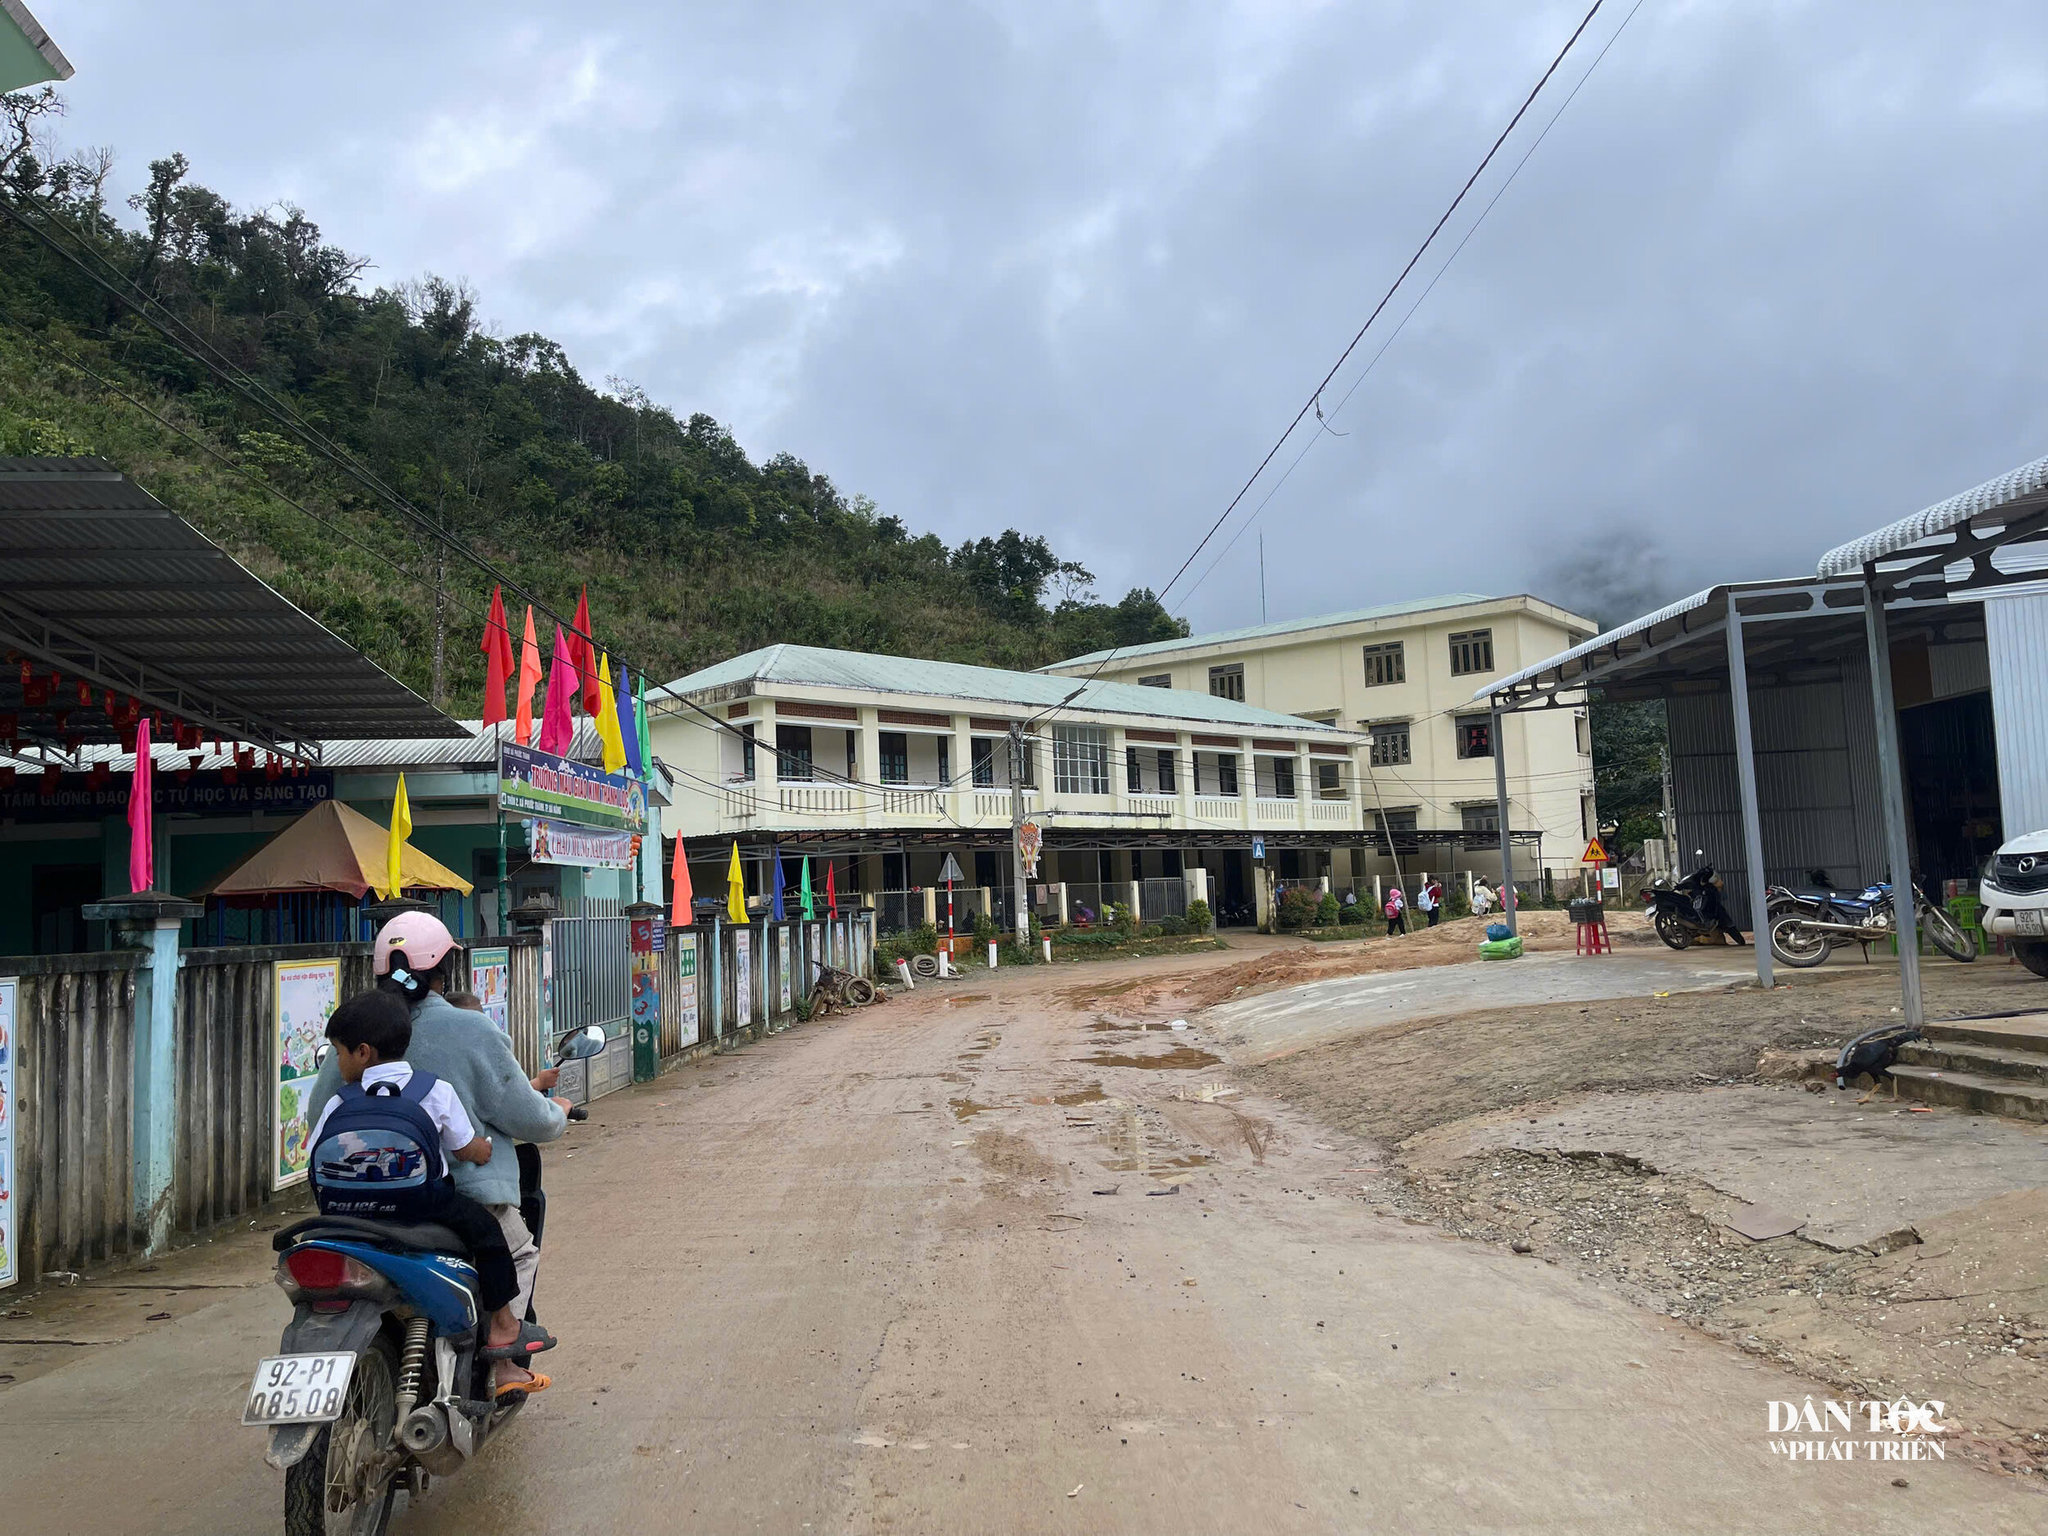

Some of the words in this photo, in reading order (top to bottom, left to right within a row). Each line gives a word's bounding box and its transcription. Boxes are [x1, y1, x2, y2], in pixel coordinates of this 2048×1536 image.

[531, 762, 558, 793] TRƯỜNG
[168, 785, 189, 805] TỰ
[193, 786, 225, 806] HỌC
[229, 783, 249, 801] VÀ
[297, 783, 328, 801] TẠO
[1255, 844, 1263, 857] A
[638, 925, 650, 940] 5
[637, 1028, 650, 1043] e
[327, 1201, 378, 1212] POLICE
[268, 1357, 336, 1387] 92-P1
